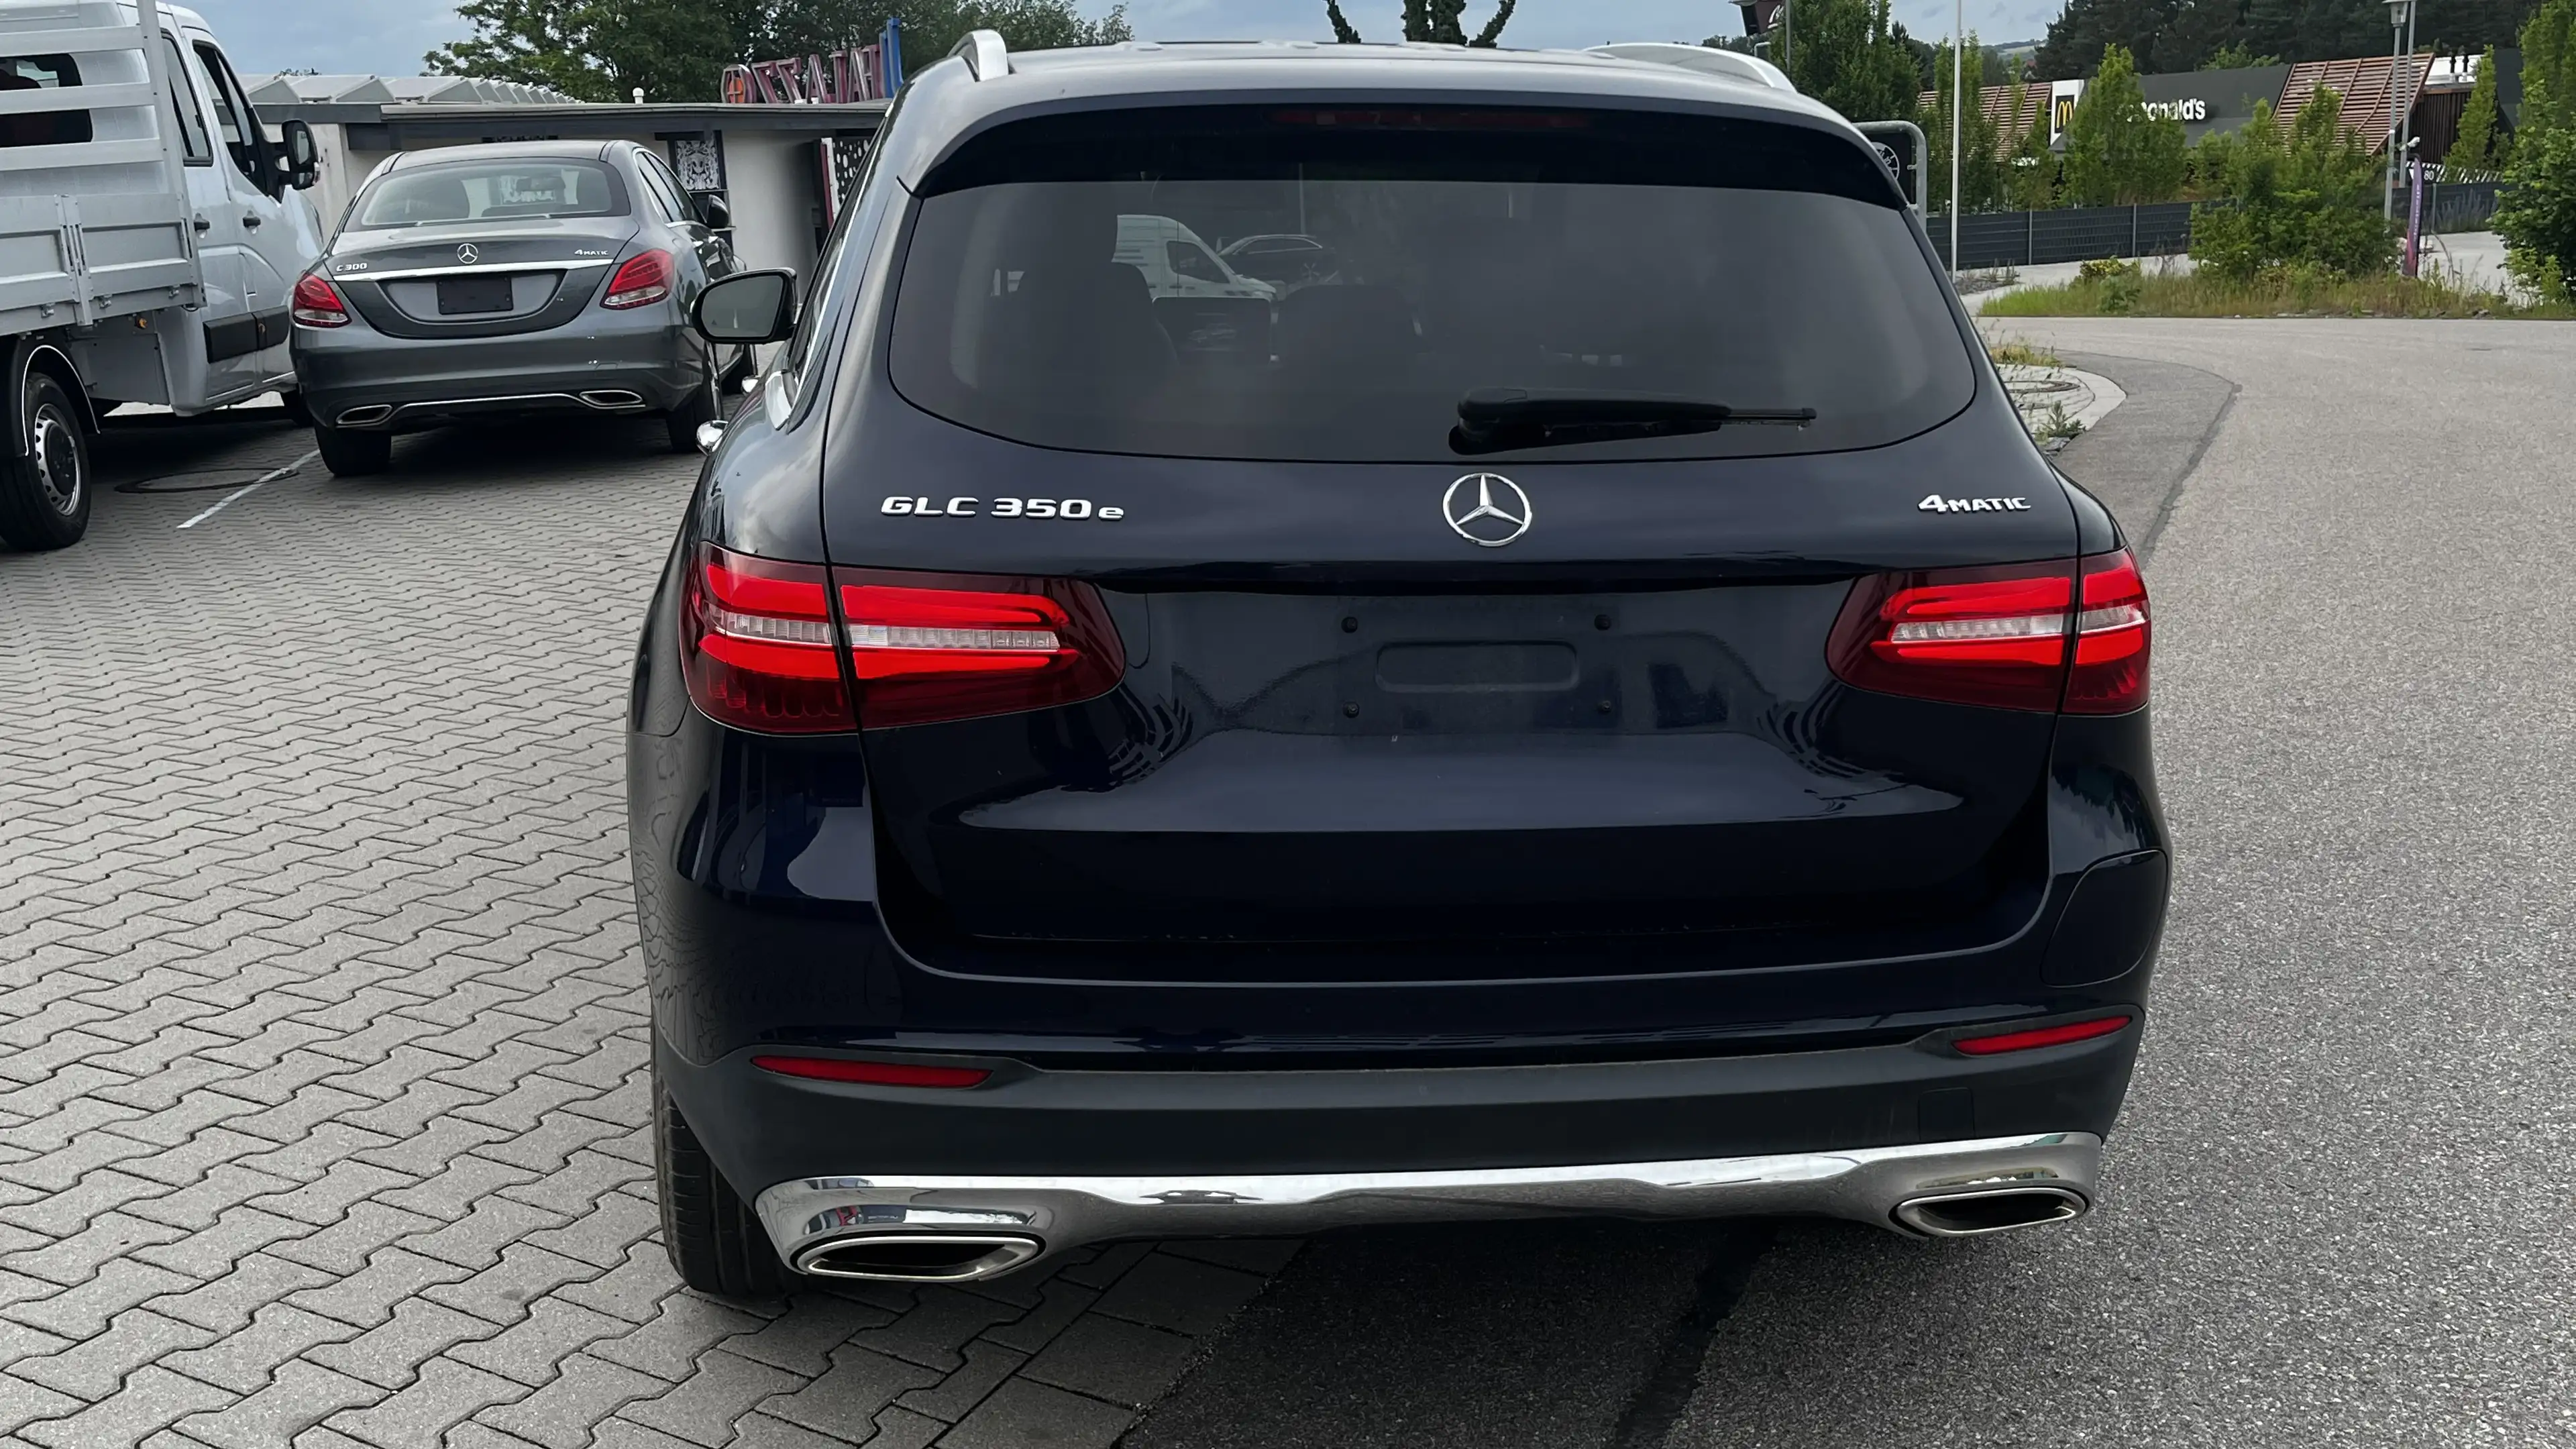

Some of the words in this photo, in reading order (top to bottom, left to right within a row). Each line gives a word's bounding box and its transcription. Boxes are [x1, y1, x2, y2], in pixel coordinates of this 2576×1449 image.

[345, 262, 368, 271] 300
[881, 496, 979, 517] GLC
[990, 497, 1124, 520] 350e
[1918, 494, 2032, 513] 4MATIC
